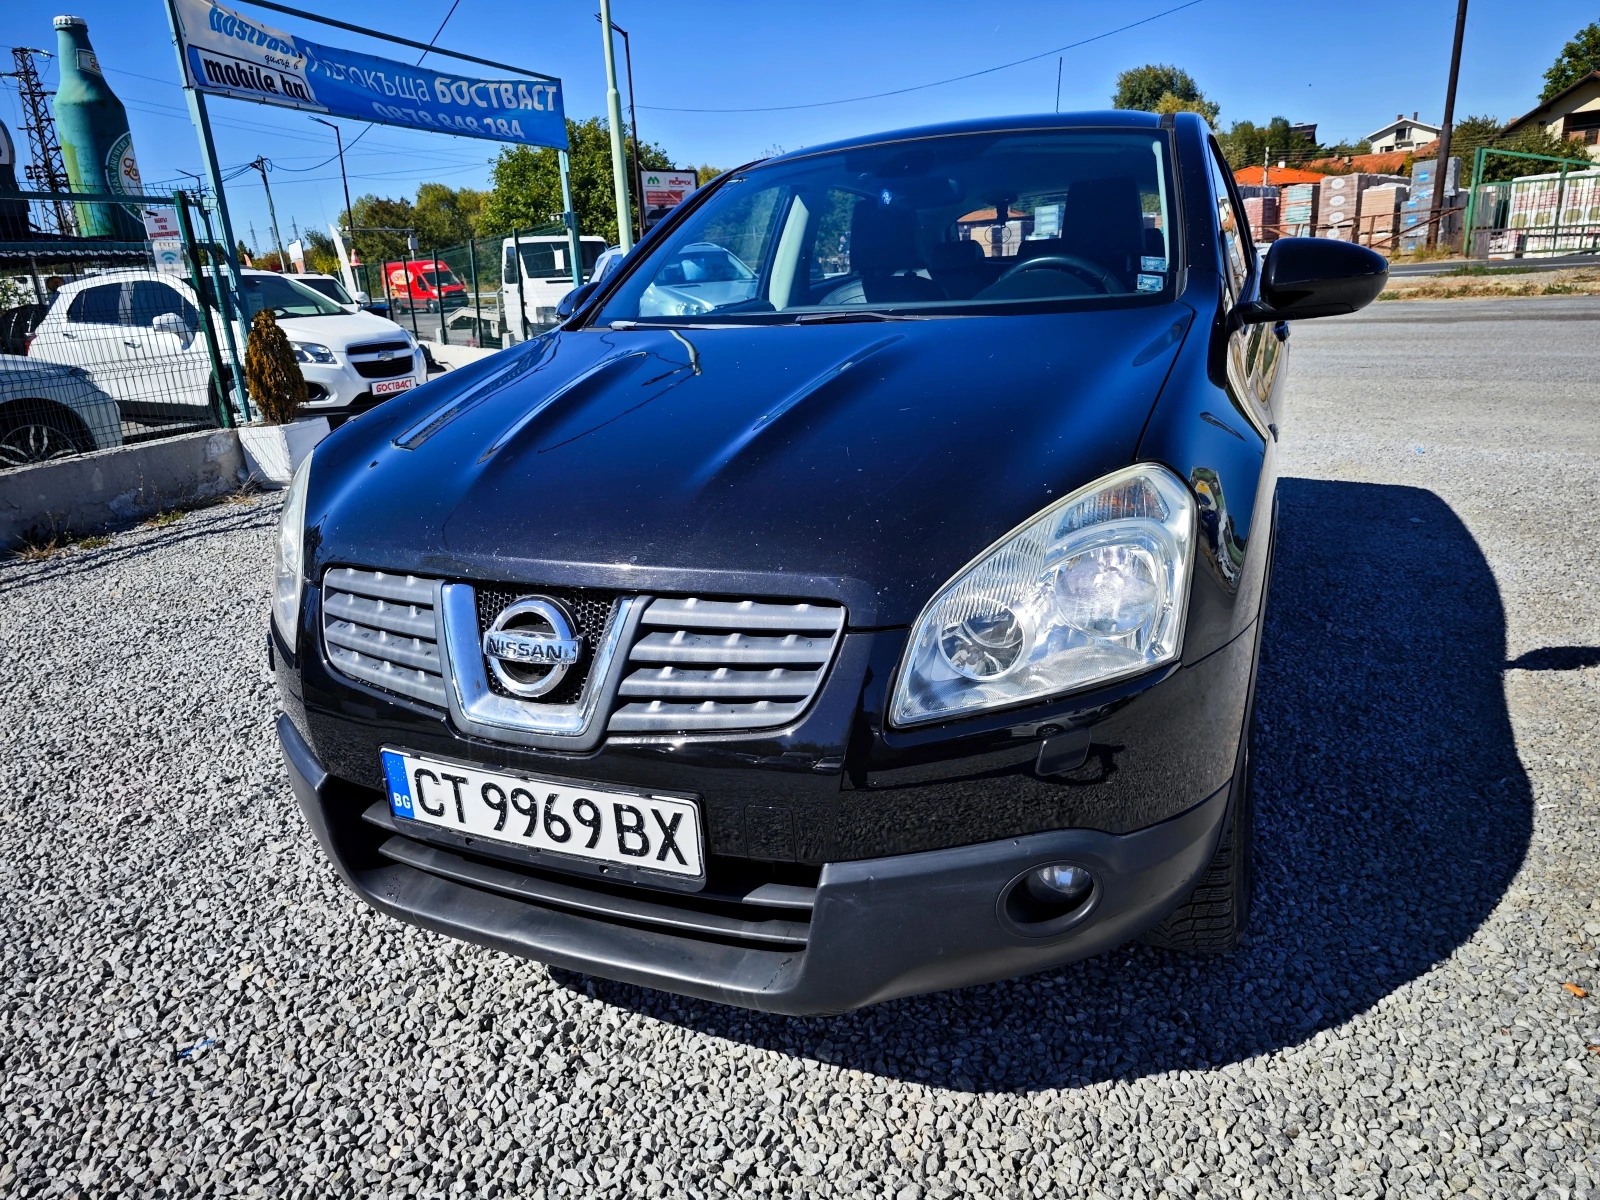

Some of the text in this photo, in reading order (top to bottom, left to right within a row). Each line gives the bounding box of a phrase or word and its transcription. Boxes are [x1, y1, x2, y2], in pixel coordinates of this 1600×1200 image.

[434, 76, 557, 113] БОСТВАСТ
[372, 101, 527, 140] 0878 848 284
[487, 638, 563, 660] NISSAN
[393, 791, 411, 810] BG
[413, 768, 689, 866] CT 9969 BX
